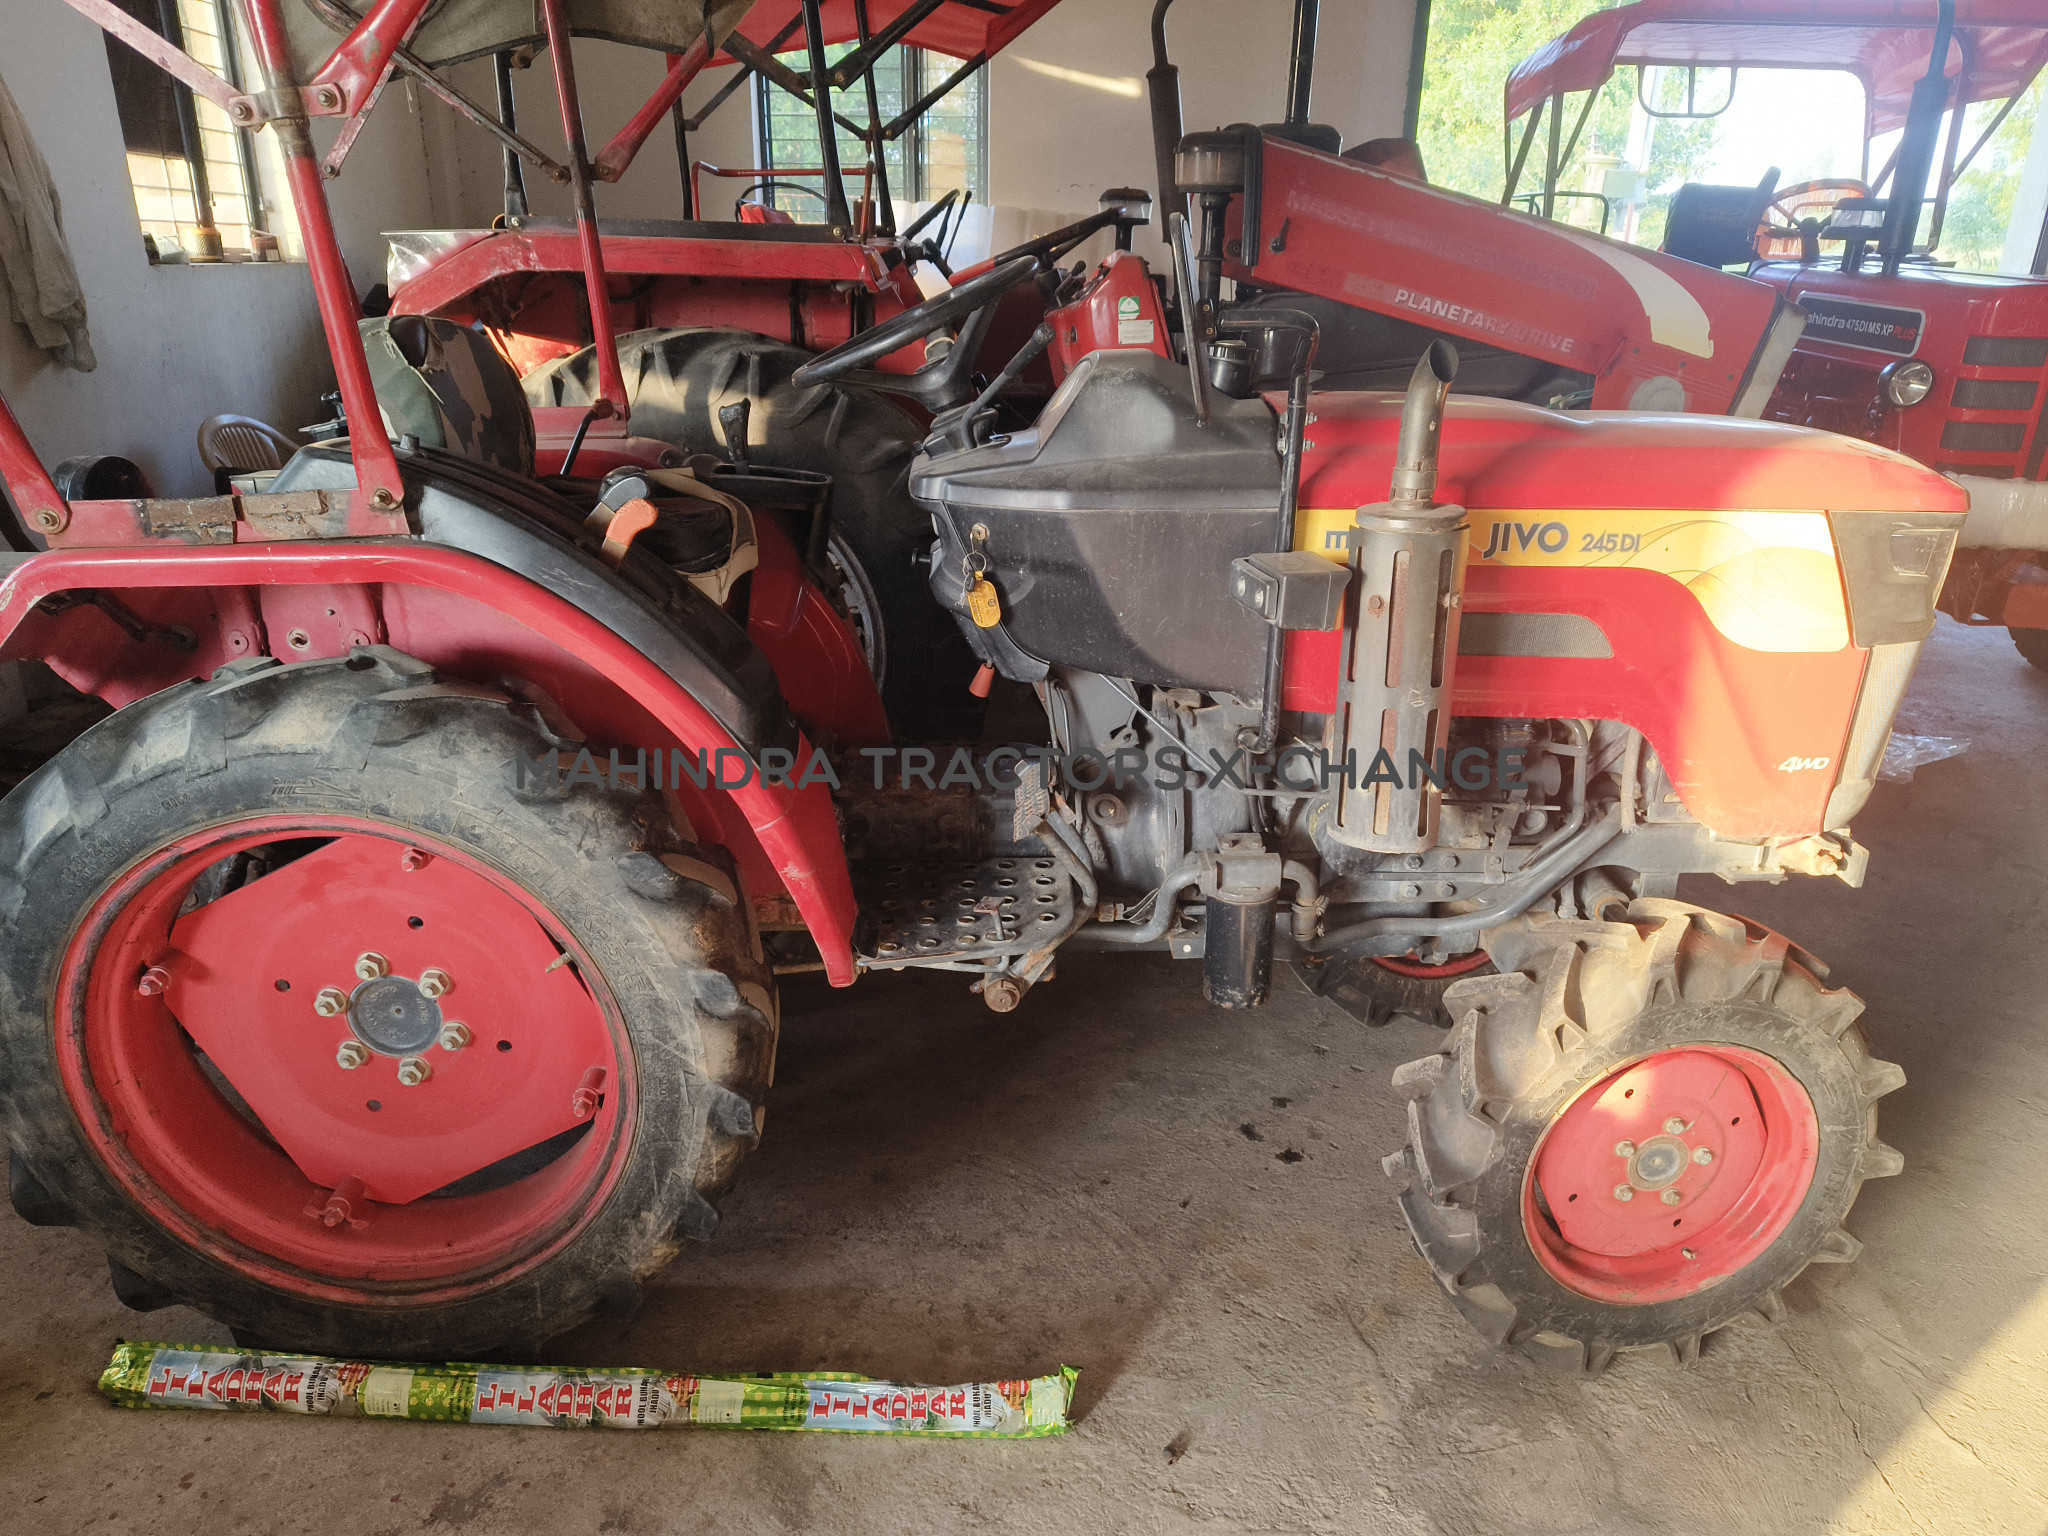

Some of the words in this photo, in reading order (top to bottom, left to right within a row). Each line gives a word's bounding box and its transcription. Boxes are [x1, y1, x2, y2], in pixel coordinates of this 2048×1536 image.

[1807, 312, 1845, 328] ahindra
[1892, 325, 1917, 340] PLUS
[1481, 521, 1569, 560] JIVO
[1777, 755, 1831, 773] 4WD
[149, 1367, 304, 1403] LILADHAR
[478, 1382, 633, 1419] LILADHAR
[648, 1389, 659, 1413] JHADU
[812, 1389, 966, 1420] LILADHAR
